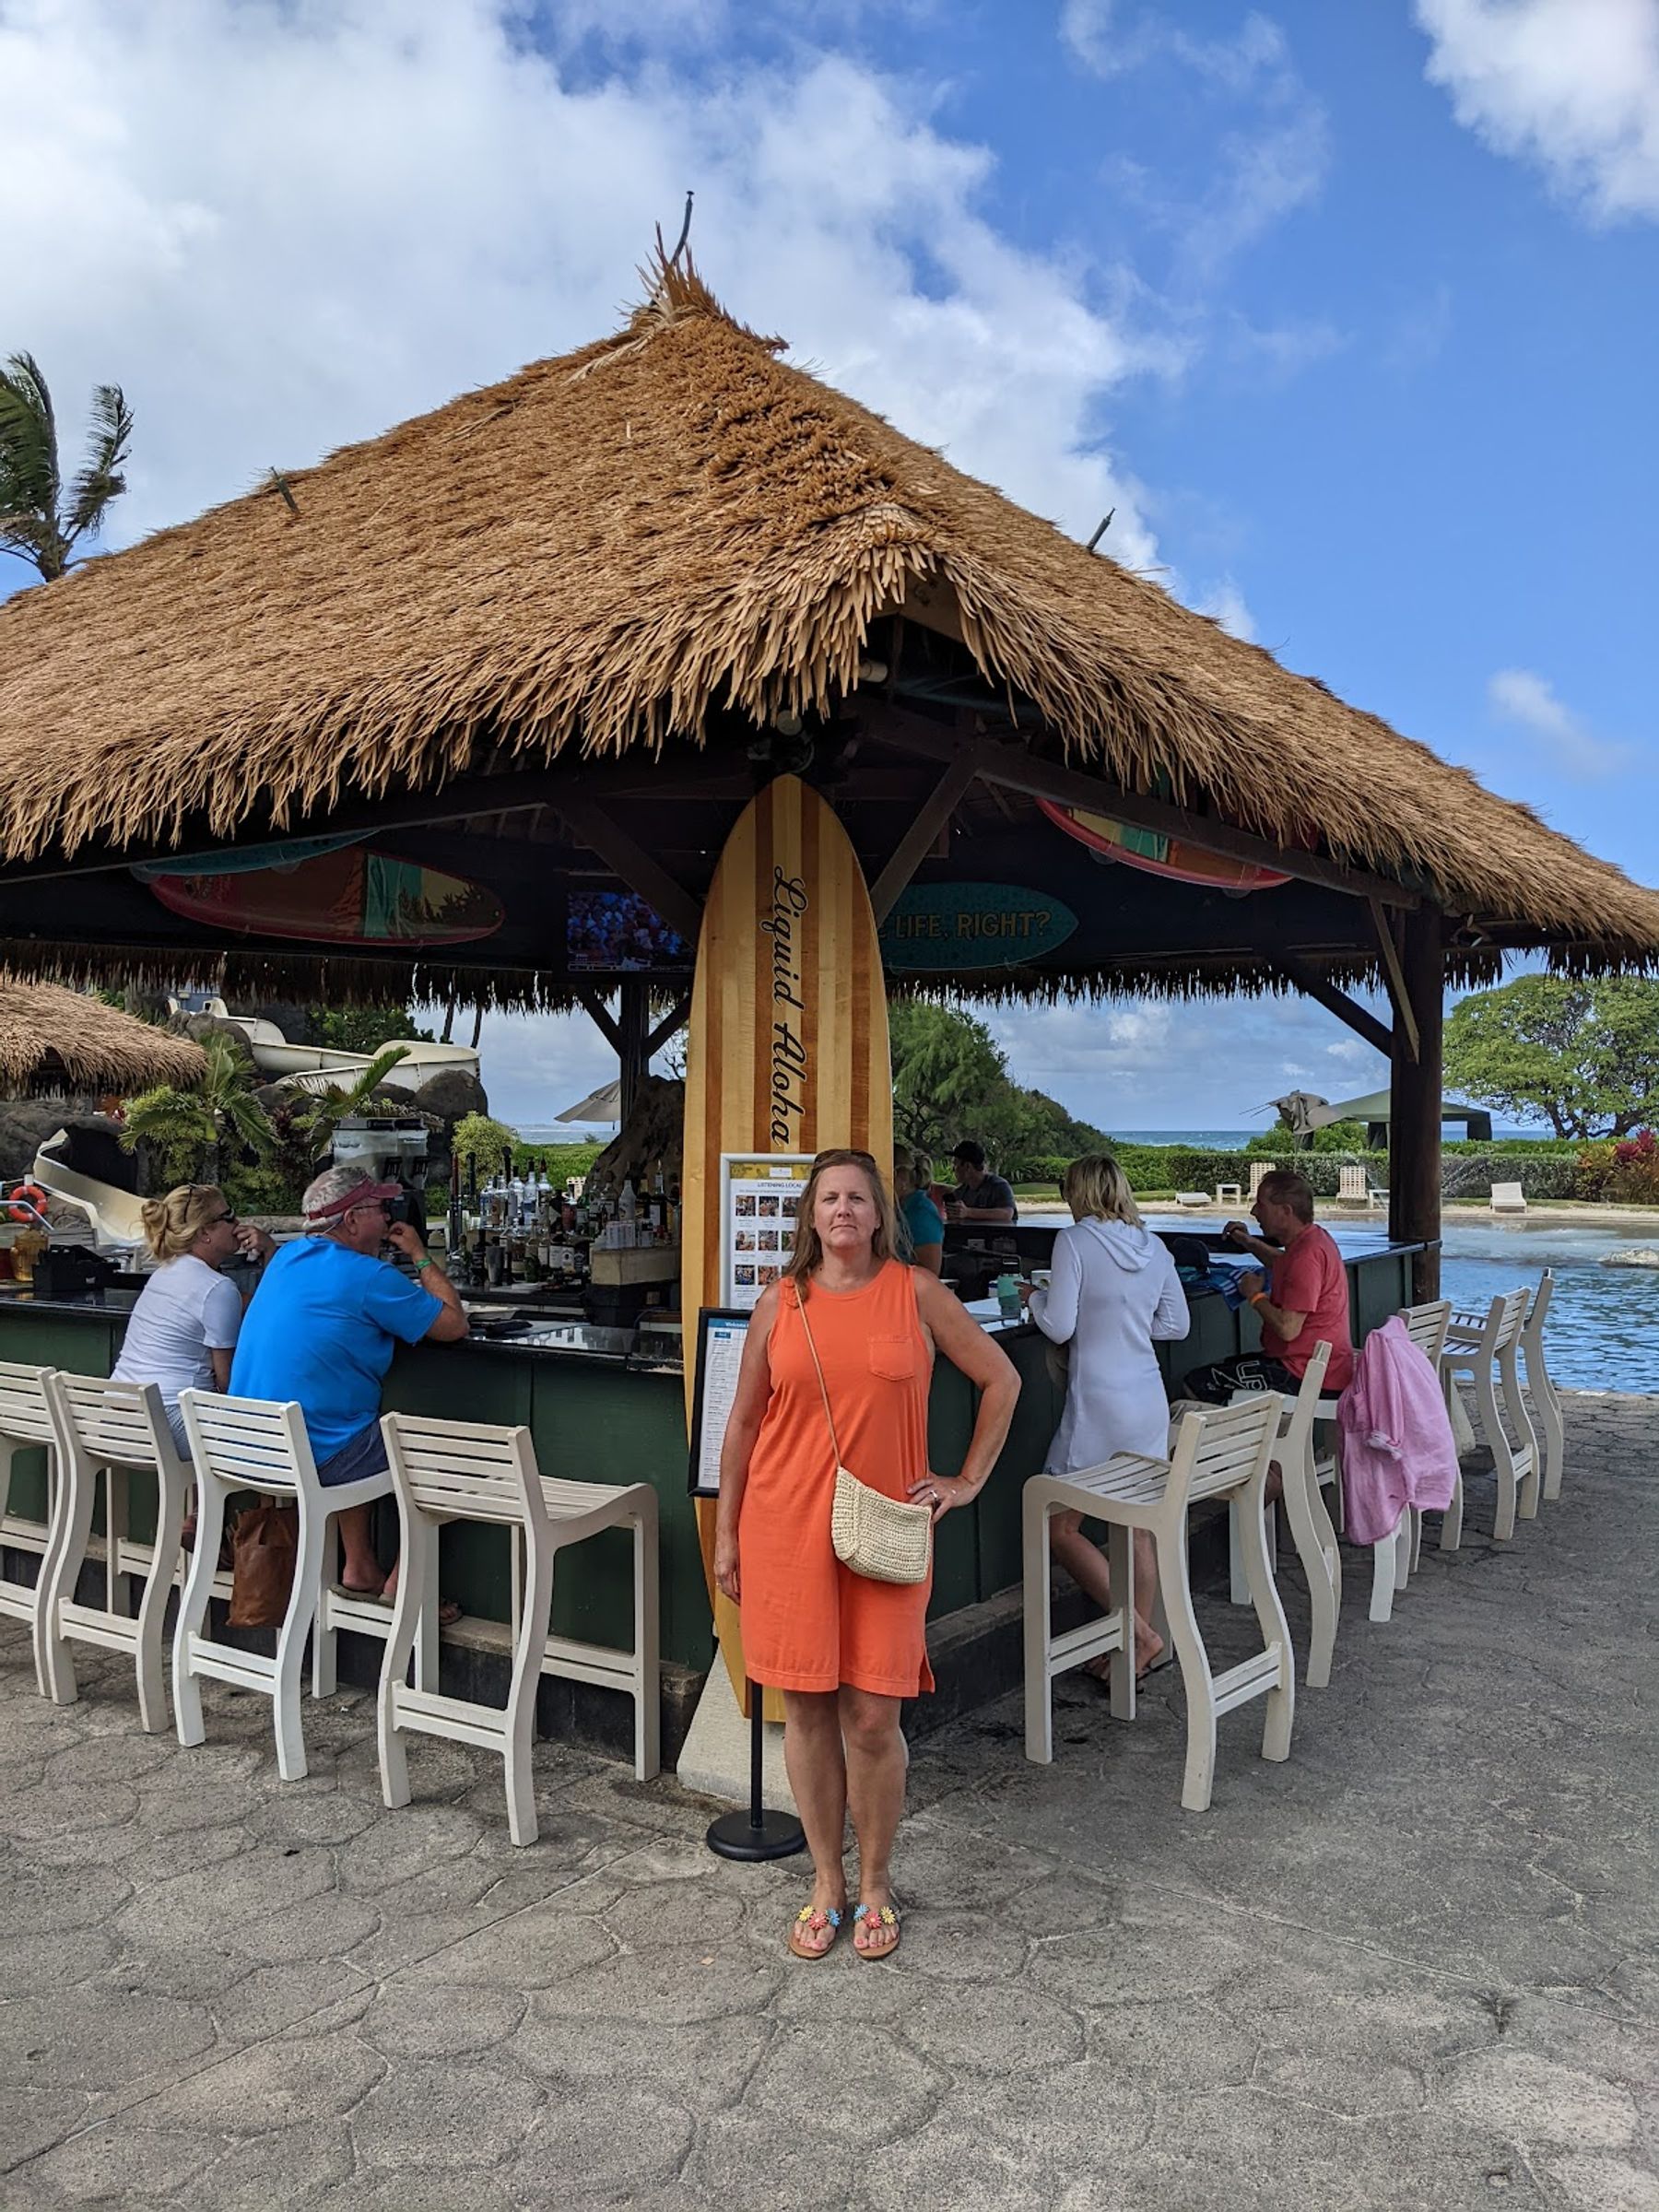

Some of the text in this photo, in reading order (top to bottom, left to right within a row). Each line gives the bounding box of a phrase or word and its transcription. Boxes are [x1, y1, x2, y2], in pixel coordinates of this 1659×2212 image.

[761, 865, 807, 1010] Liquid
[896, 914, 949, 940] LIFE,
[956, 912, 1051, 940] RIGHT?
[771, 1022, 806, 1147] Aloha
